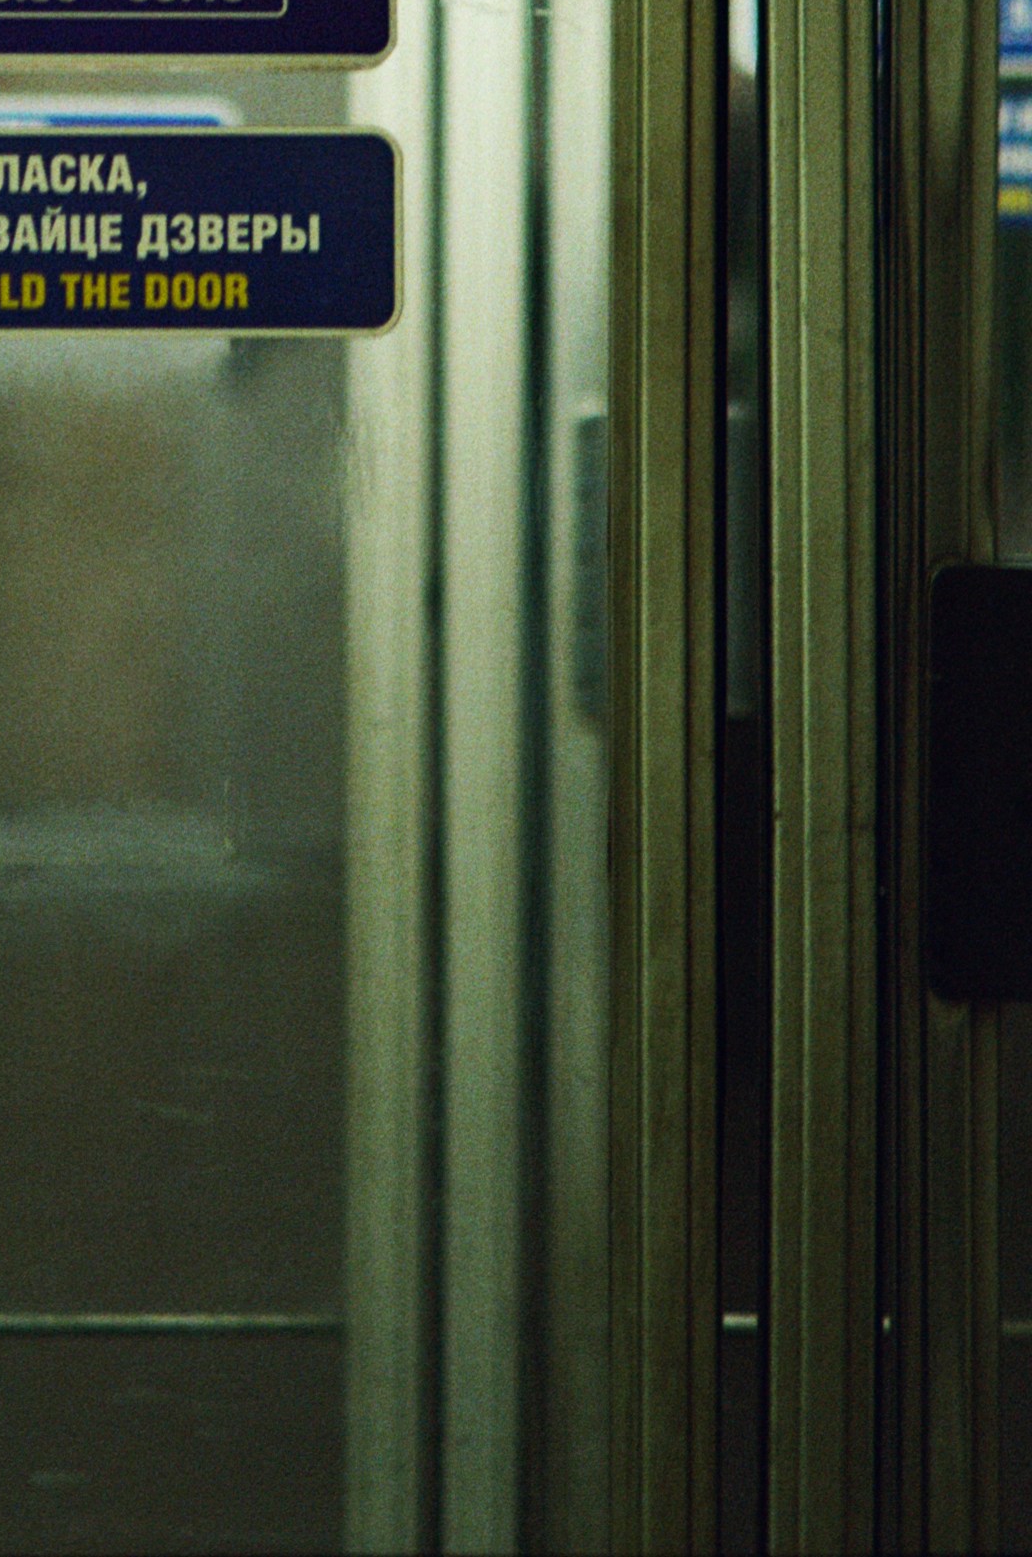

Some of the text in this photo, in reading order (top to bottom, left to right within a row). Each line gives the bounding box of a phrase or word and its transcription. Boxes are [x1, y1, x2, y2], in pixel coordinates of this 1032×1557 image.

[136, 213, 321, 260] ДЗВЕРЫ
[60, 273, 131, 309] THE
[143, 272, 249, 310] DOOR
